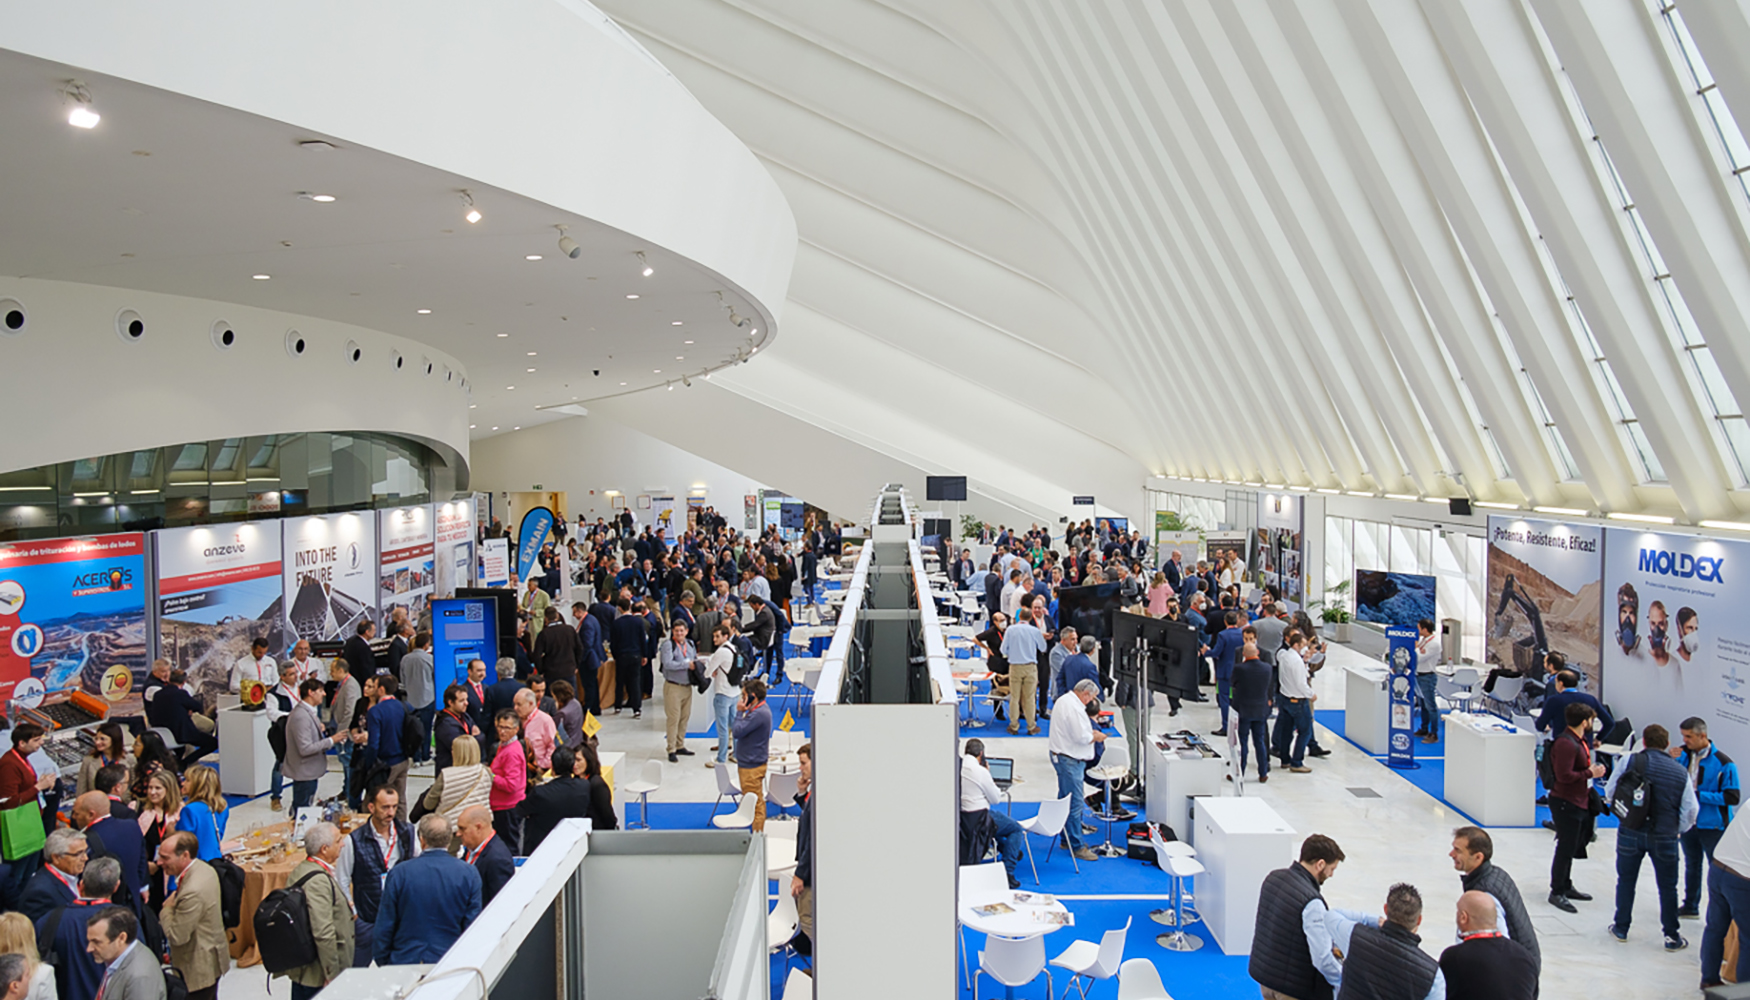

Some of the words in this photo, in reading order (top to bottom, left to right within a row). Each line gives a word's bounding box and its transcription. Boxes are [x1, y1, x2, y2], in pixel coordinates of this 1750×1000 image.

[30, 548, 38, 556] de
[82, 543, 108, 551] bombas
[109, 541, 117, 549] de
[118, 540, 136, 548] lodos
[522, 518, 548, 563] EXMAIN
[1494, 527, 1525, 545] ¡Potente,
[1526, 530, 1568, 551] Resistente,
[1569, 535, 1596, 552] Eficaz!
[295, 550, 318, 567] INTO
[319, 546, 337, 563] THE
[1638, 548, 1724, 584] MOLDEX
[296, 566, 333, 588] FUTURE
[1388, 630, 1416, 638] MOLDEX
